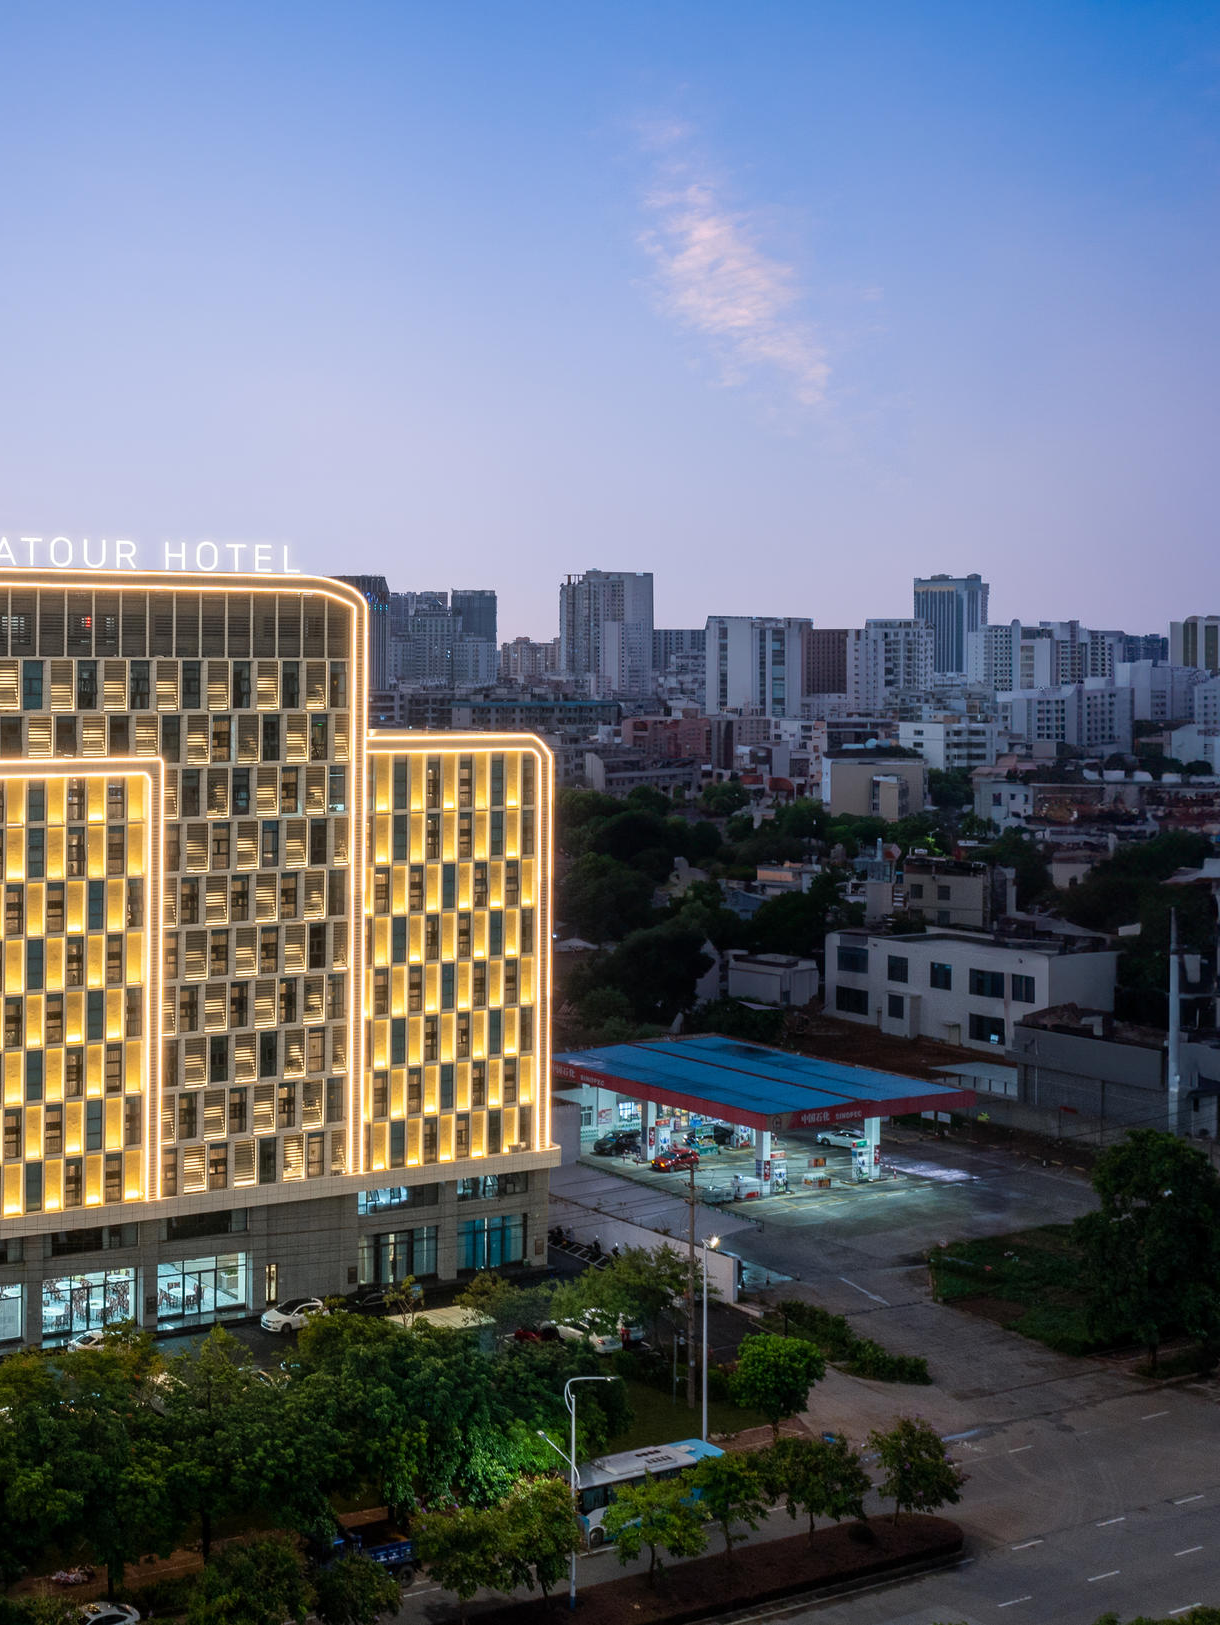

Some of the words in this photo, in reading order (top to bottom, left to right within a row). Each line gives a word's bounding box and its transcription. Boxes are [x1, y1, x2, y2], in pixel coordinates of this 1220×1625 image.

[164, 541, 301, 574] HOTEL
[800, 1111, 831, 1125] 中国石化
[835, 1110, 862, 1120] SINOPEC
